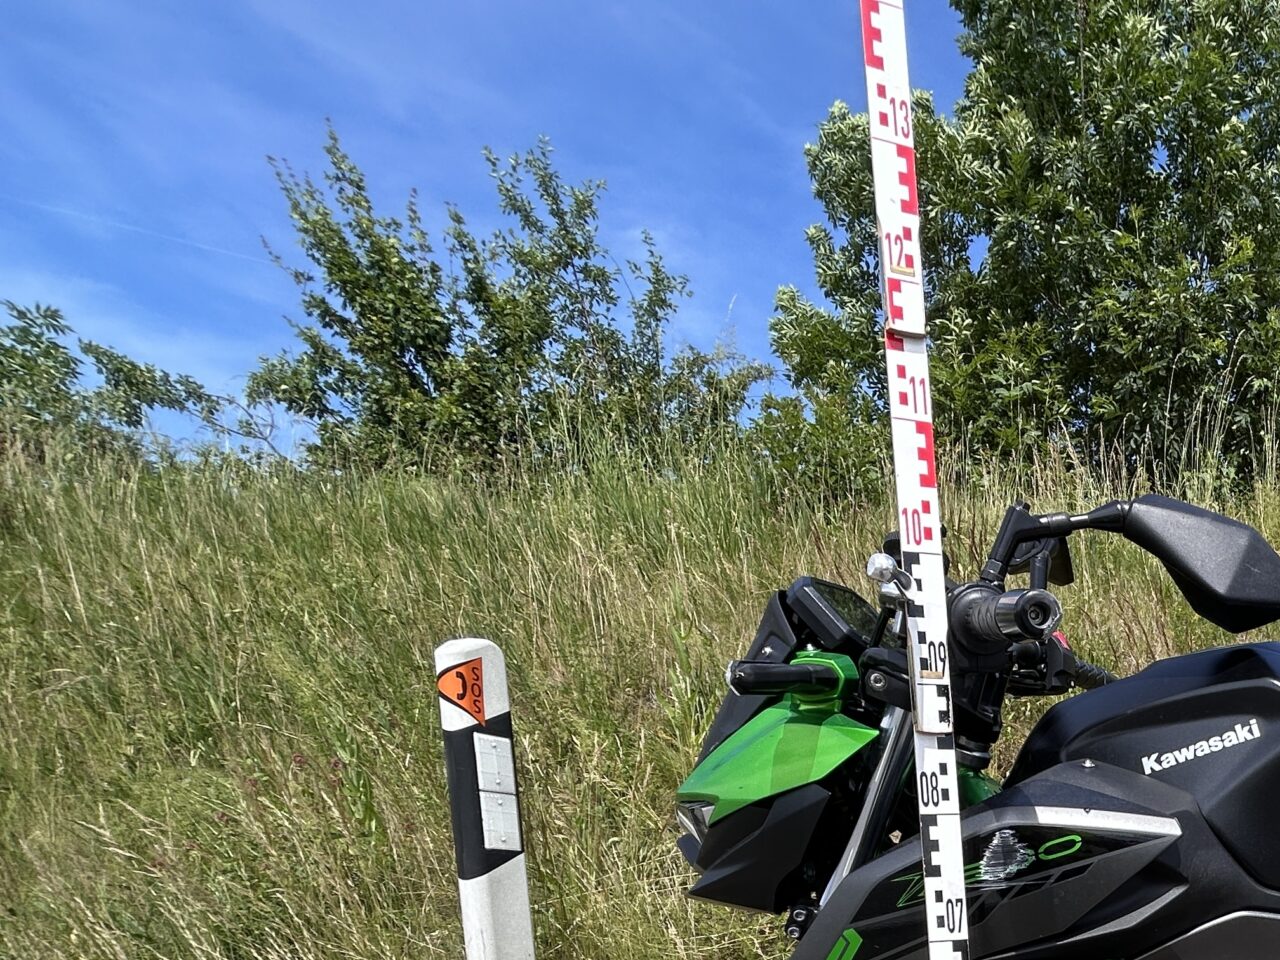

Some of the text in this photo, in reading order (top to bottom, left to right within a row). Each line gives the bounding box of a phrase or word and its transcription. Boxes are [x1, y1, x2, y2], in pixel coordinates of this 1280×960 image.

[889, 97, 911, 140] 13
[884, 232, 905, 271] 12
[909, 377, 928, 415] 11
[901, 508, 923, 546] 10
[927, 640, 947, 677] 09
[470, 666, 483, 714] SOS
[1141, 718, 1261, 775] Kawasaki
[919, 771, 940, 807] 08
[945, 898, 964, 934] 07
